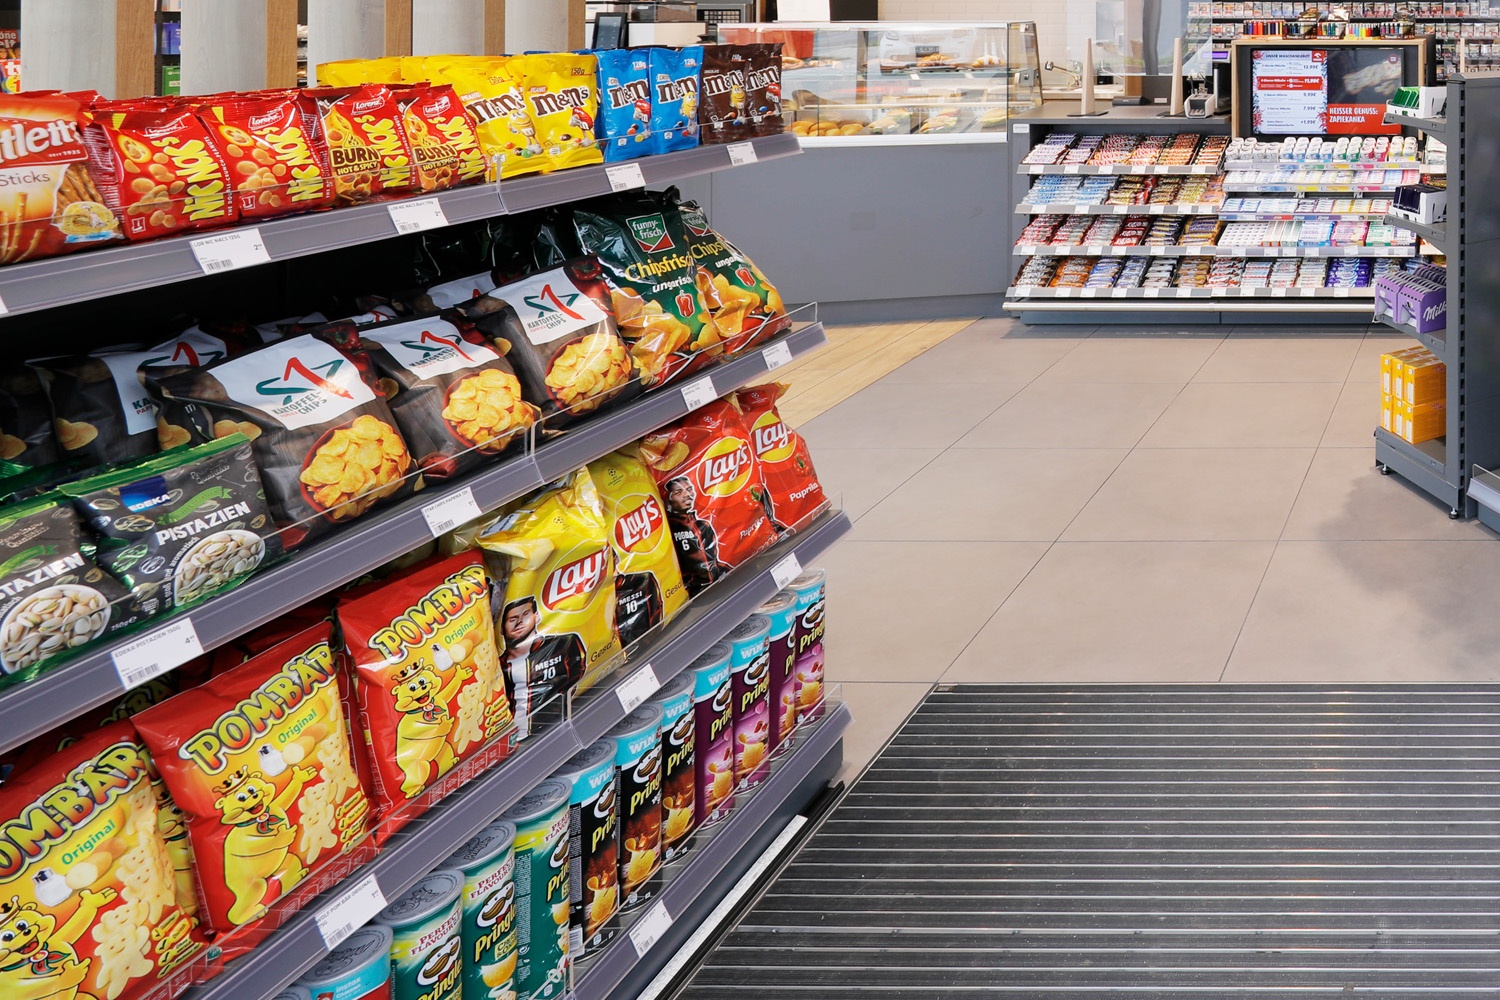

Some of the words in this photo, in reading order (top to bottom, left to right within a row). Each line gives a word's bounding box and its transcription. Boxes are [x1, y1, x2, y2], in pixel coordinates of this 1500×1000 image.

[355, 98, 384, 109] Lorenz
[333, 148, 379, 166] BURN
[416, 144, 455, 162] BURN
[0, 171, 50, 187] Sticks
[632, 219, 659, 230] funny-
[639, 227, 663, 239] frisch
[271, 390, 322, 416] KARTOFFEL-
[298, 397, 328, 415] CHIPS
[704, 444, 750, 489] Lay's
[129, 494, 170, 513] EDEKA
[155, 501, 251, 546] PISTAZIEN
[622, 501, 661, 548] Lay's
[682, 539, 690, 551] 6
[619, 591, 643, 605] MESSI
[800, 589, 819, 604] WIN
[626, 600, 638, 614] 10
[444, 616, 476, 645] Original
[115, 646, 135, 657] EDEKA
[136, 632, 166, 647] PISTAZIEN
[741, 644, 762, 659] WIN
[535, 656, 562, 671] MESSI
[543, 667, 555, 680] 10
[708, 667, 729, 686] WIN
[666, 700, 688, 718] WIN
[278, 708, 317, 743] Original
[629, 734, 656, 754] WIN
[61, 819, 116, 865] Original
[352, 879, 372, 896] ORIGINAL
